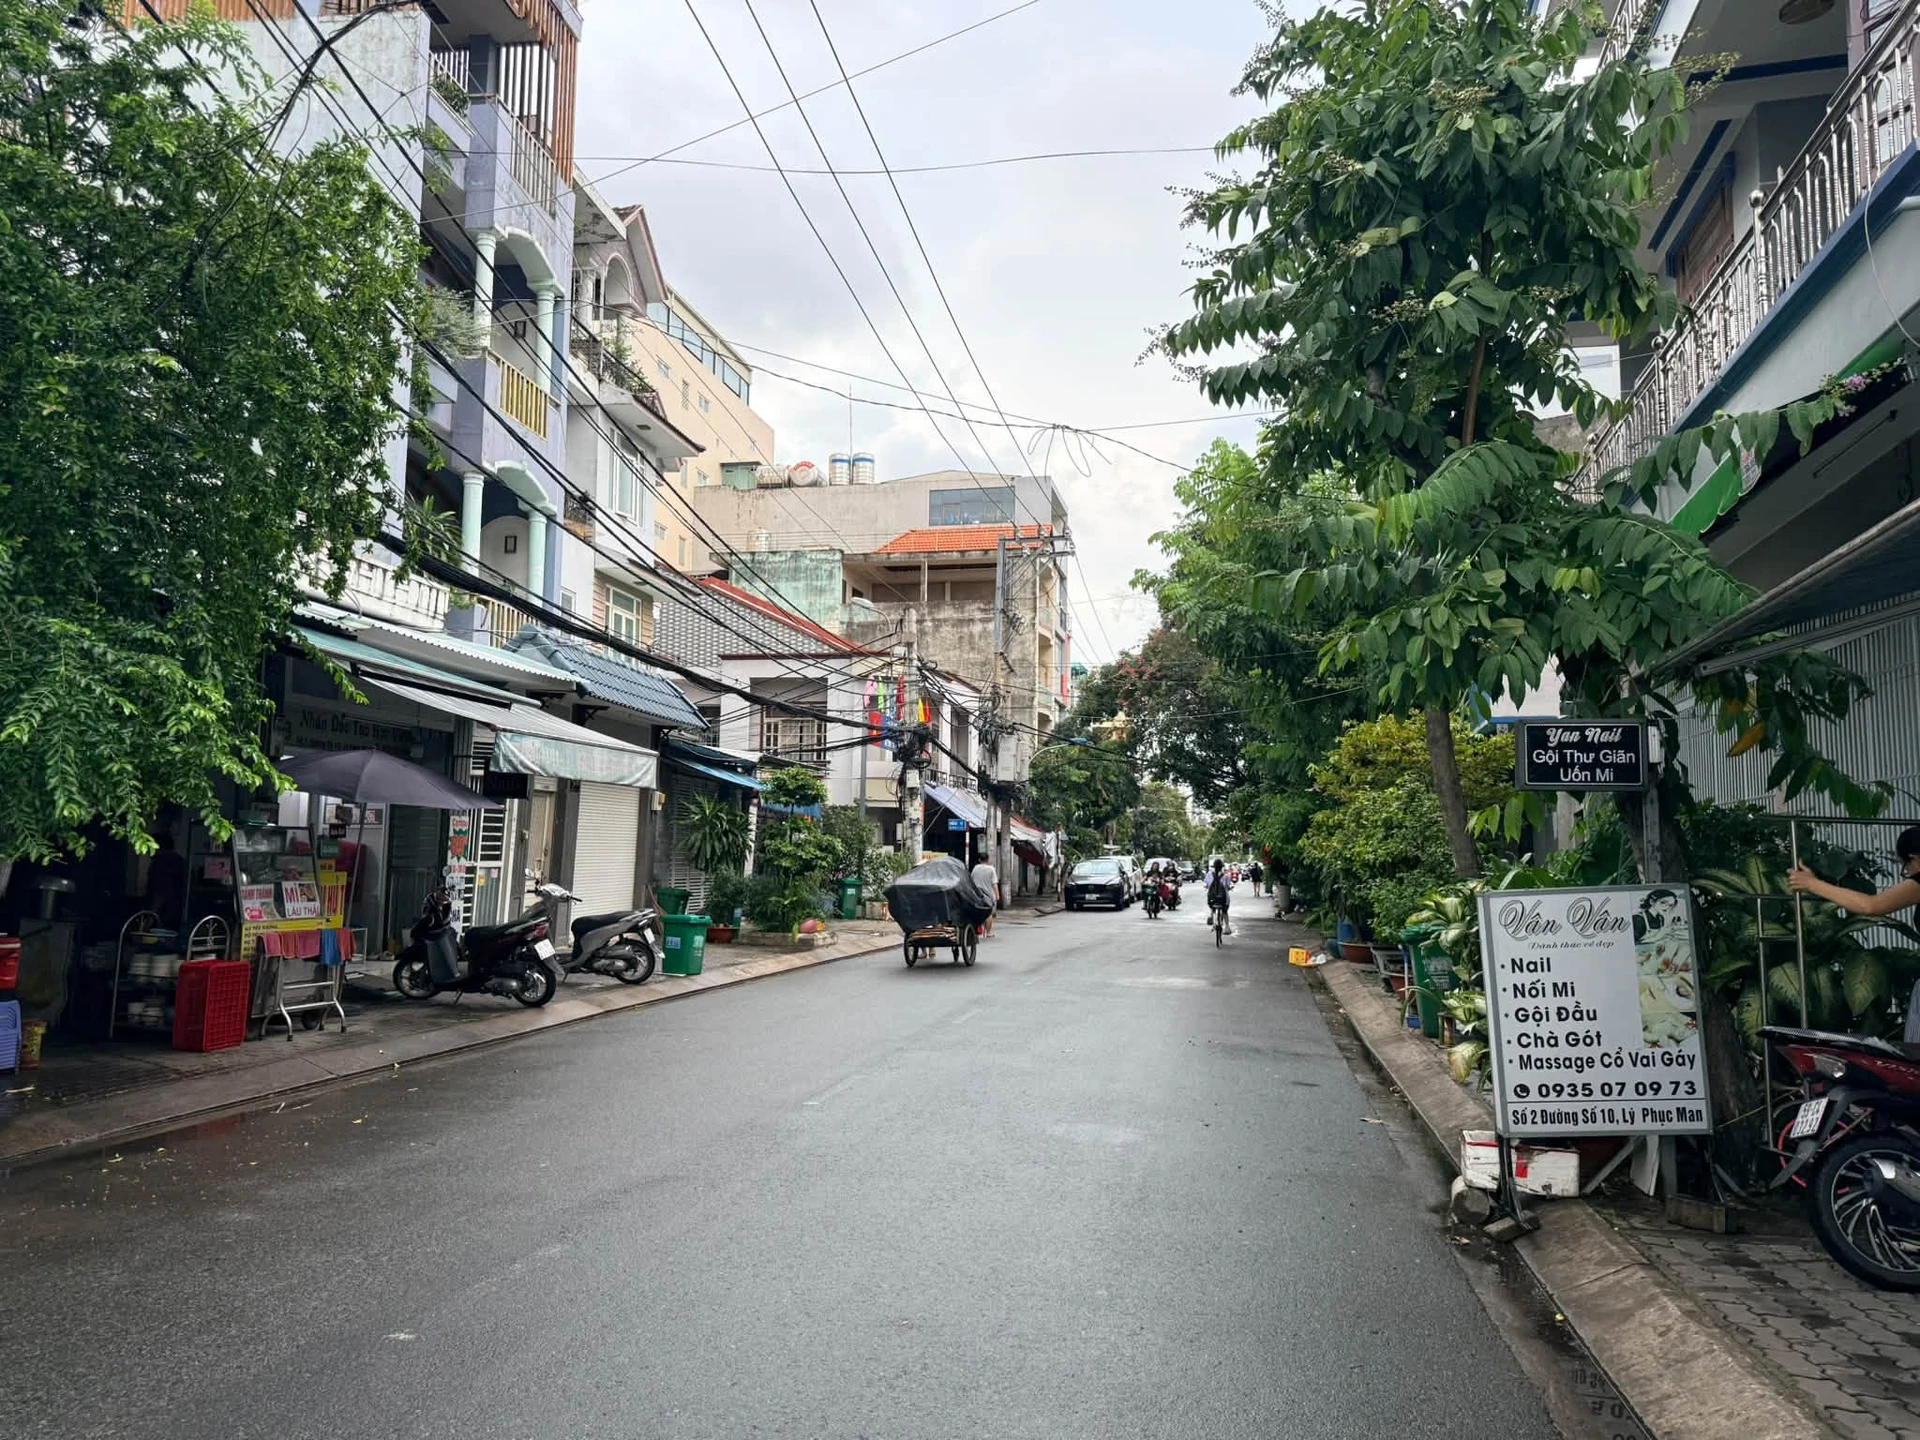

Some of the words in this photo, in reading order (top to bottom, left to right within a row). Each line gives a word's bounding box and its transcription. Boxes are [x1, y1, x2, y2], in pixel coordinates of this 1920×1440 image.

[1546, 727, 1581, 747] Yan
[1584, 727, 1623, 744] Nail
[1532, 749, 1559, 766] Gội
[1563, 749, 1595, 764] Thư
[1599, 749, 1636, 764] Giãn
[1560, 765, 1591, 782] Uốn
[1596, 768, 1614, 782] Mi
[1498, 899, 1563, 942] Vân
[1566, 896, 1631, 939] Vân
[1511, 957, 1551, 973] Nail
[1512, 979, 1546, 998] Nối
[1552, 982, 1576, 998] Mi
[1514, 1005, 1550, 1027] Gội
[1556, 1001, 1597, 1022] Đầu
[1517, 1030, 1559, 1048] Chà
[1565, 1030, 1602, 1047] Gót
[1519, 1054, 1595, 1074] Massage
[1600, 1047, 1624, 1068] Cổ
[1629, 1051, 1656, 1067] Vai
[1660, 1049, 1696, 1070] Gáy
[1537, 1083, 1594, 1098] 0935
[1600, 1082, 1627, 1096] 07
[1634, 1081, 1662, 1096] 09
[1669, 1080, 1697, 1095] 73
[1512, 1106, 1527, 1125] Số
[1530, 1110, 1538, 1125] 2
[1540, 1109, 1578, 1126] Đường
[1581, 1105, 1597, 1124] Số
[1600, 1108, 1619, 1125] 10,
[1622, 1107, 1635, 1125] Lý
[1642, 1107, 1673, 1127] Phục
[1676, 1106, 1703, 1123] Man
